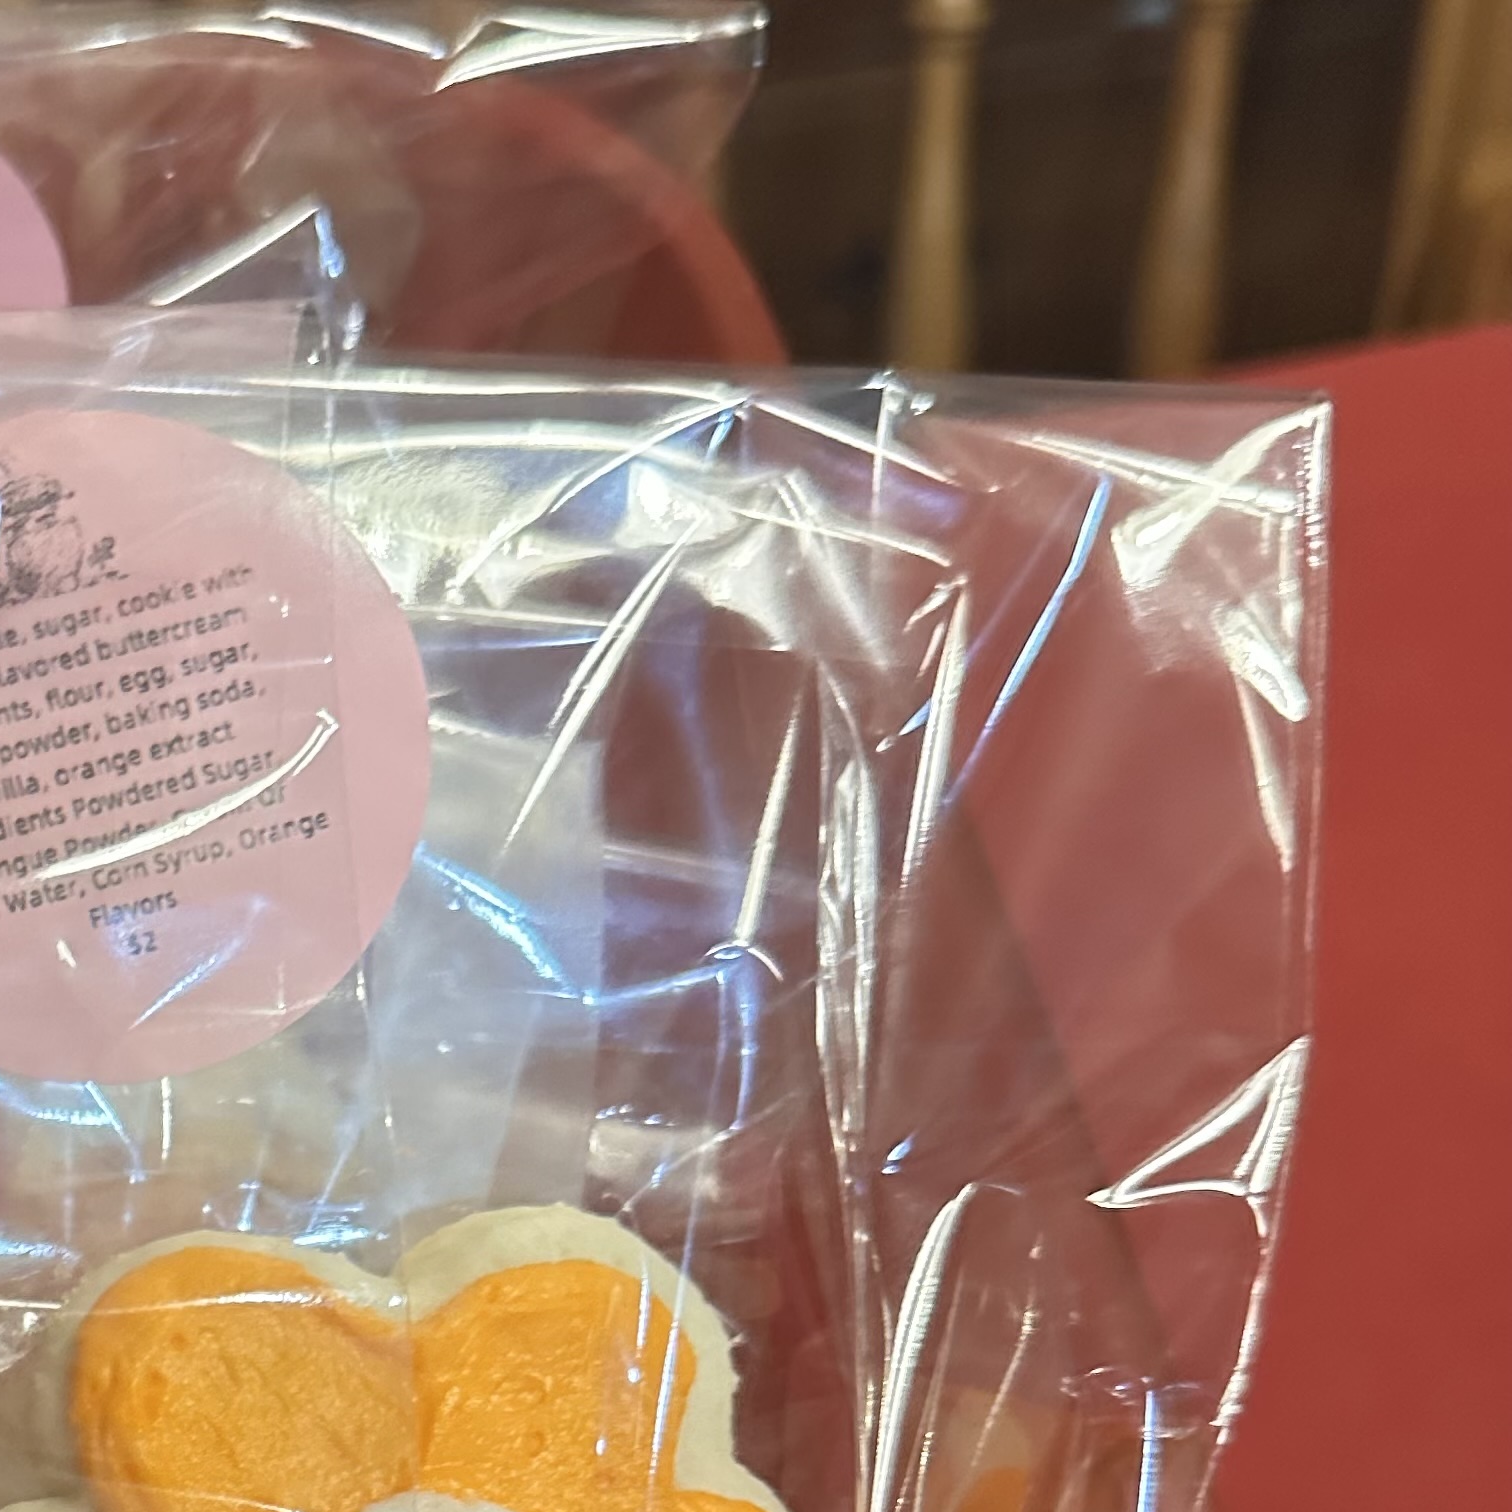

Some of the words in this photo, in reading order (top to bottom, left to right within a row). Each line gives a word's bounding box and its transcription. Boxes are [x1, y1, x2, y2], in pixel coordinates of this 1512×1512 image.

[31, 605, 112, 641] sugar,
[116, 581, 198, 619] cookie
[94, 606, 248, 662] buttercream
[44, 680, 115, 712] flour,
[118, 665, 174, 695] egg,
[180, 642, 259, 678] sugar,
[104, 696, 192, 736] baking
[195, 679, 267, 712] soda,
[53, 748, 143, 787] orange
[149, 721, 237, 762] extract
[71, 766, 199, 821] Powdered
[2, 879, 87, 915] Water,
[91, 860, 150, 893] Corn
[152, 840, 234, 876] Syrup,
[239, 811, 331, 851] Orange
[88, 890, 181, 930] Flavors
